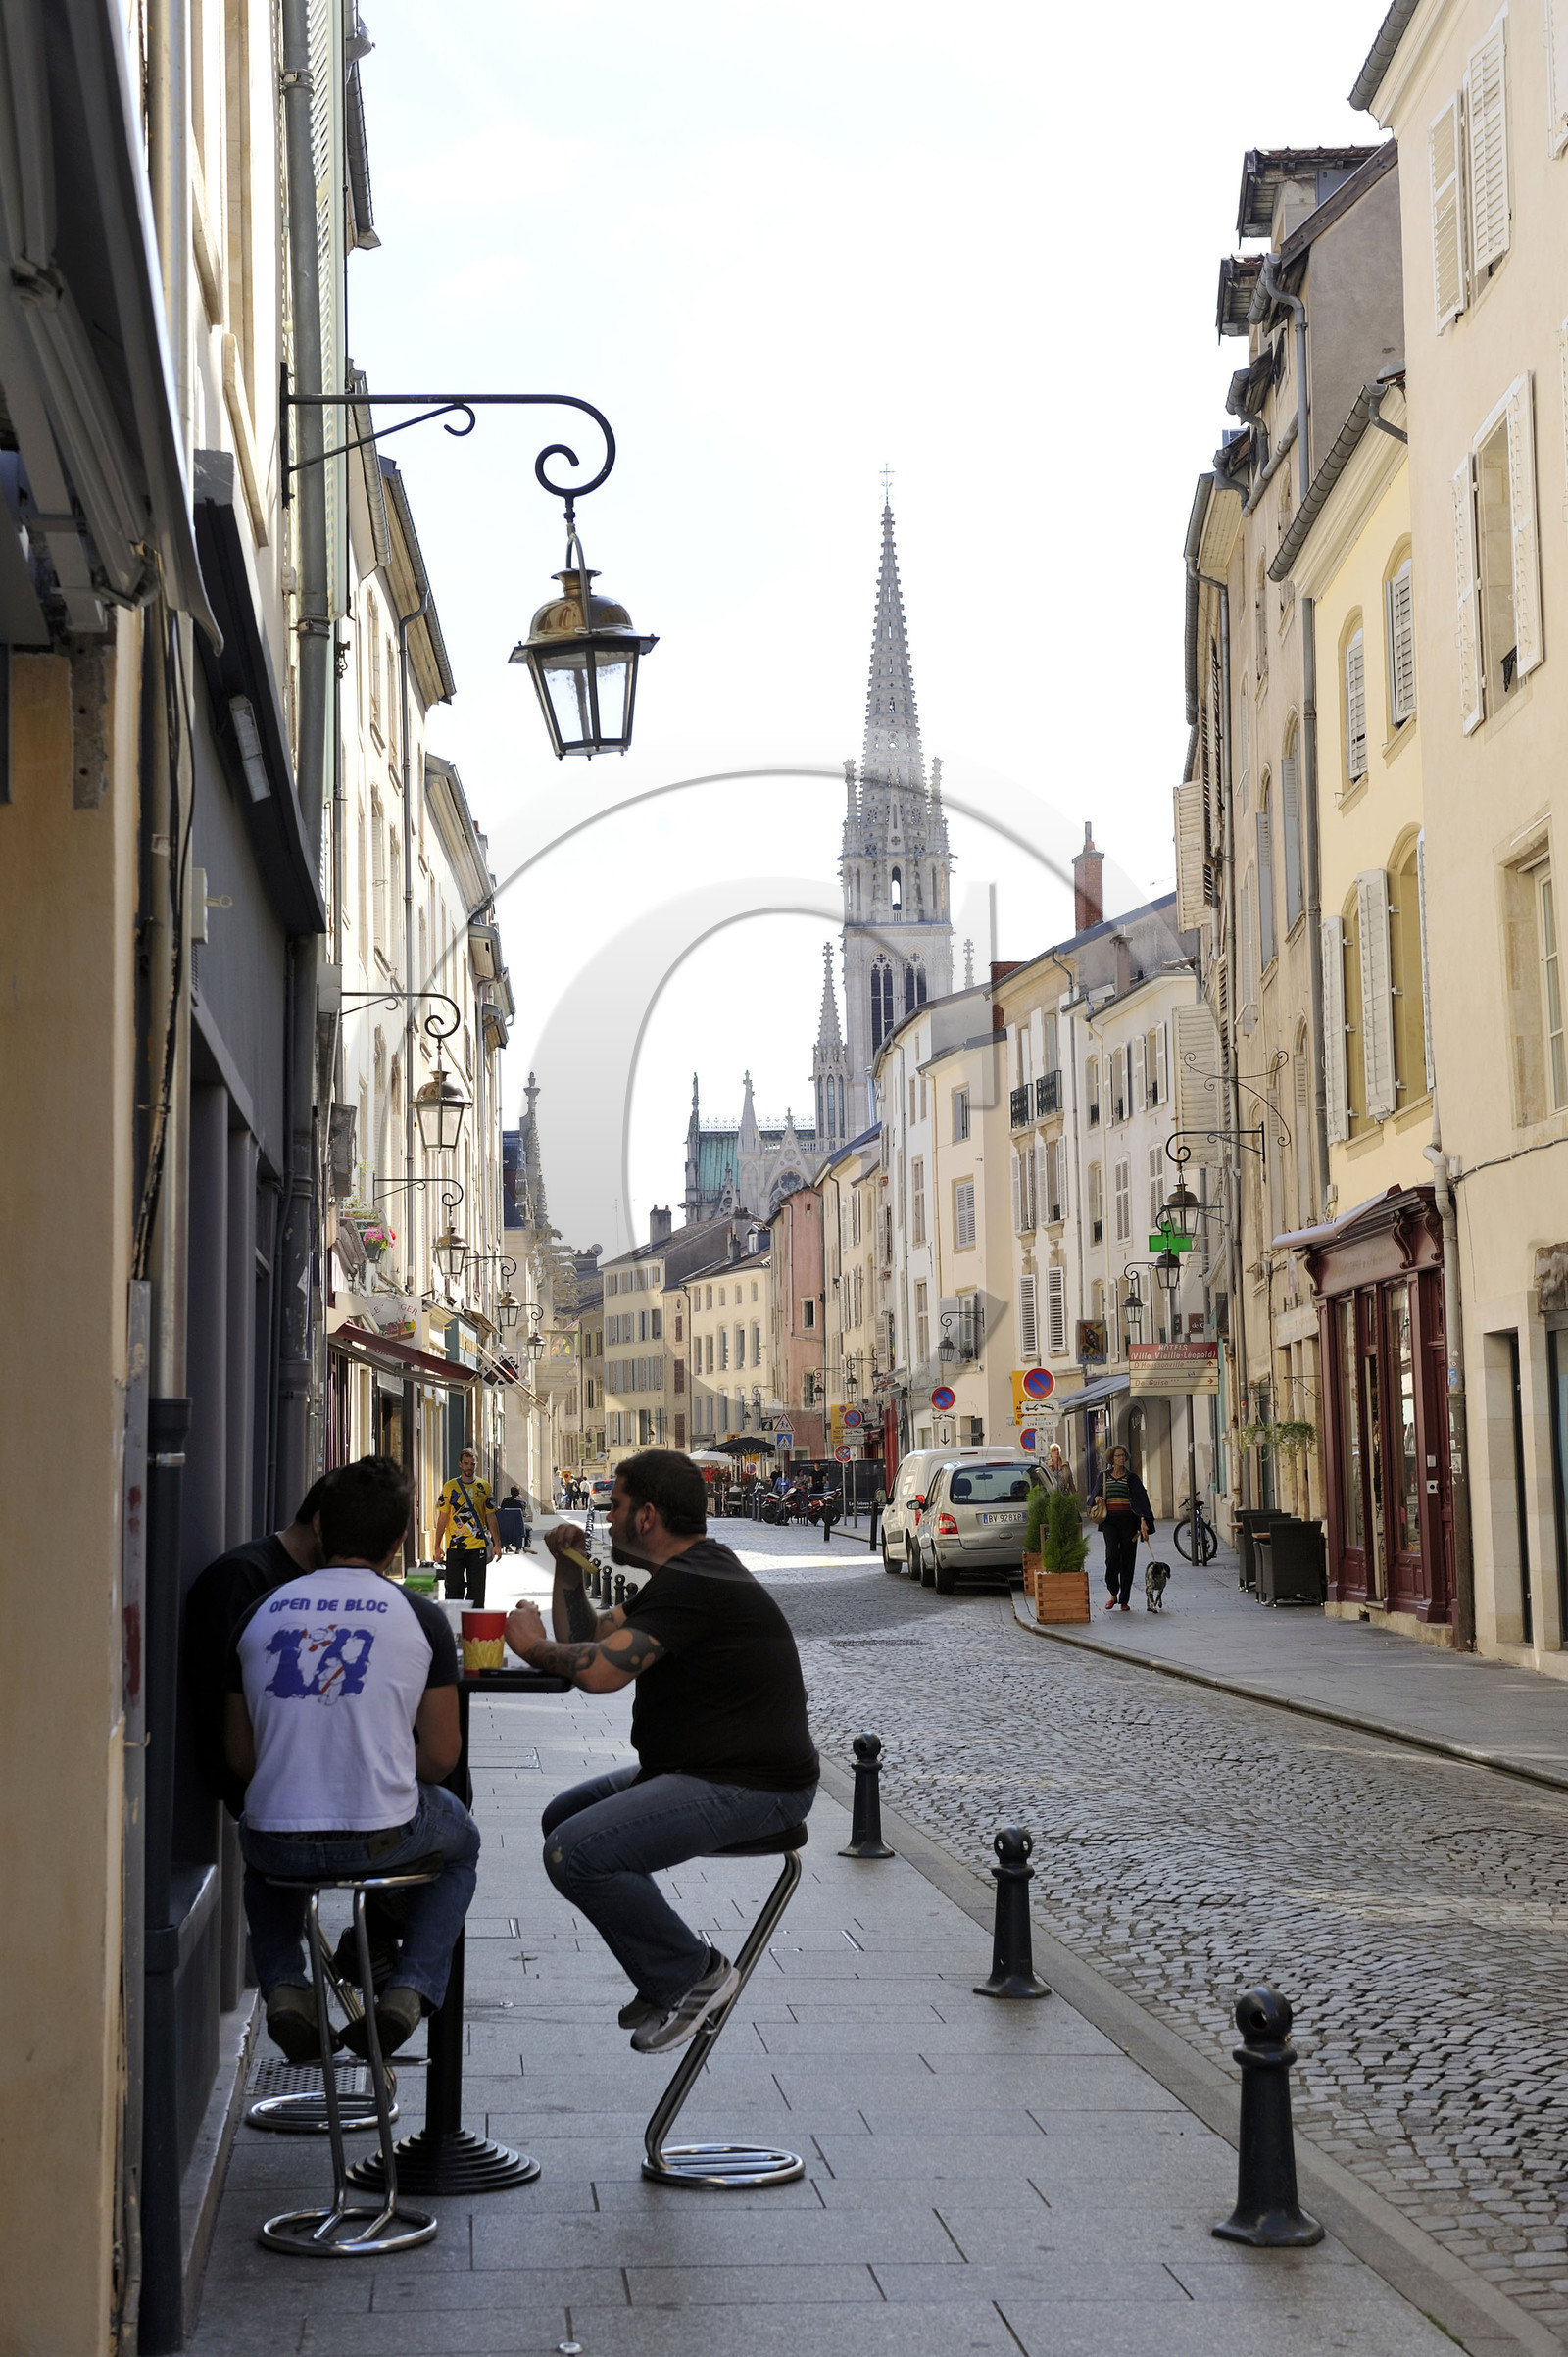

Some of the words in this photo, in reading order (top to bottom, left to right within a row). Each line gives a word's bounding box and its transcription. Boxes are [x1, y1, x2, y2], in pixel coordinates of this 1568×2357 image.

[1157, 1343, 1188, 1351] HÔTELS
[269, 1597, 312, 1615] OPEN
[317, 1598, 339, 1612] DE
[344, 1598, 389, 1615] BLOC
